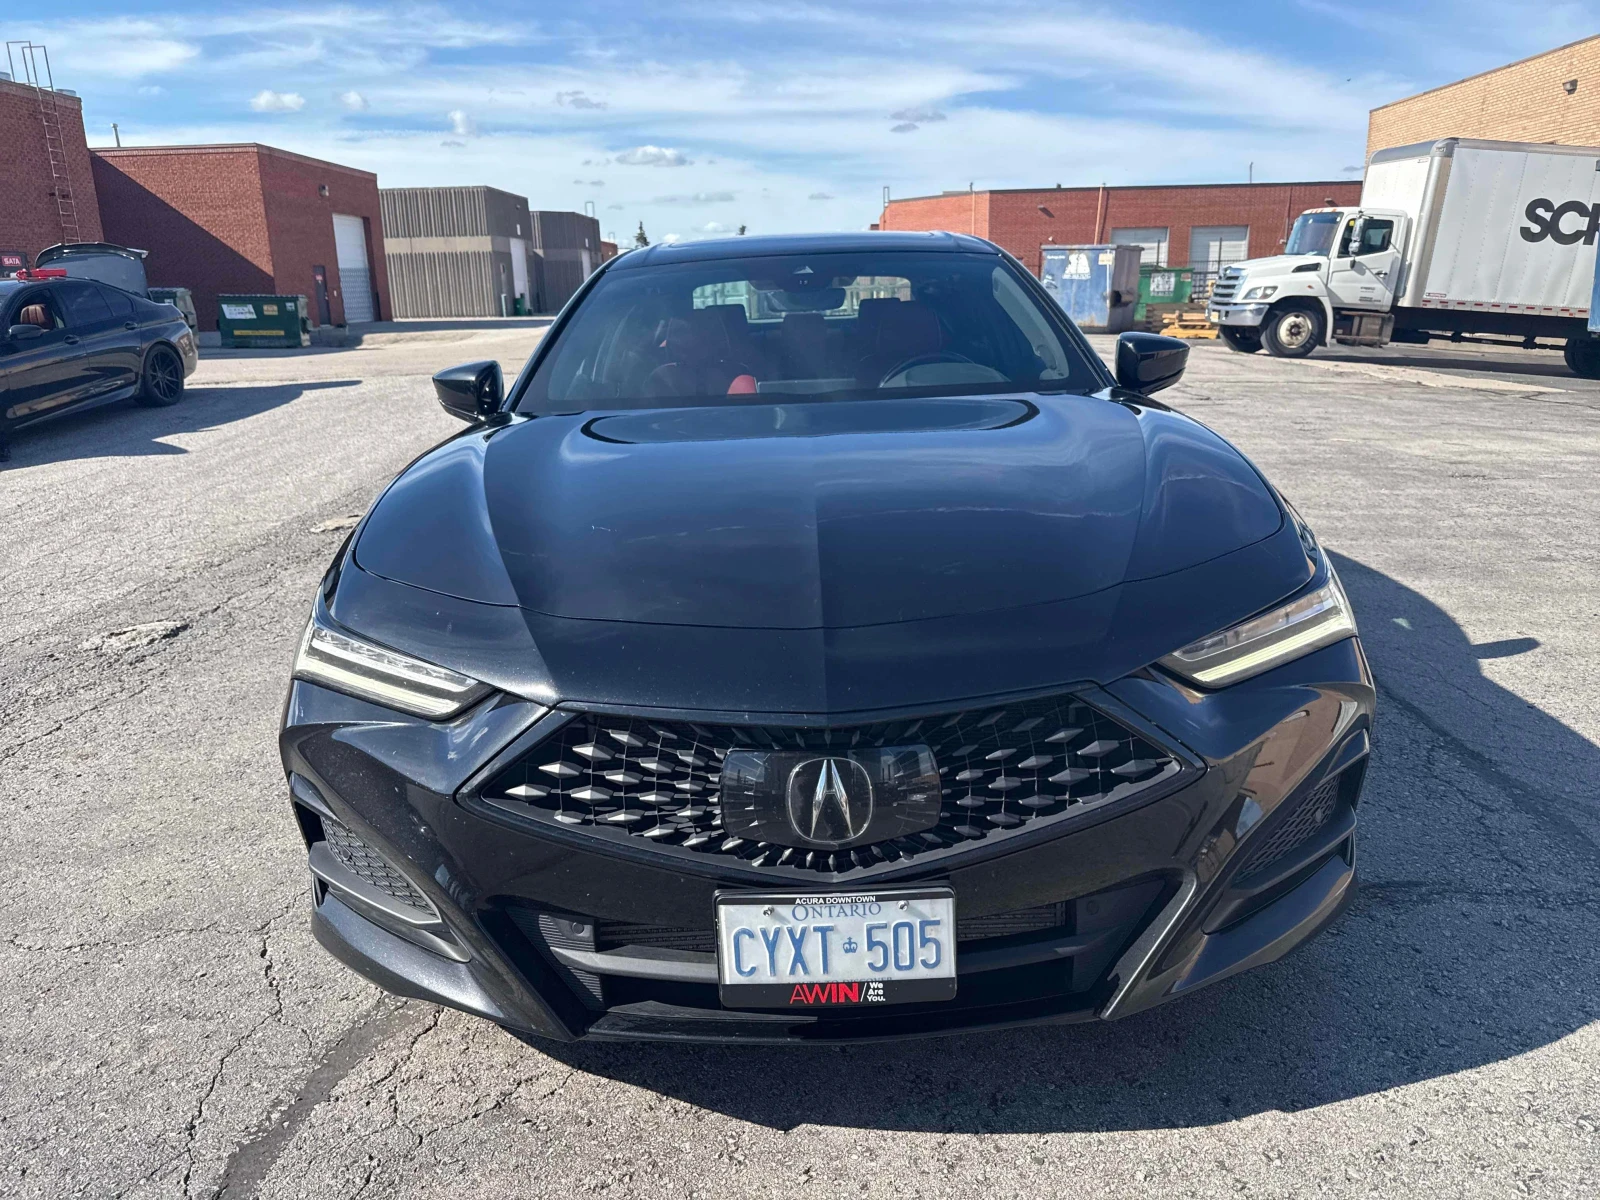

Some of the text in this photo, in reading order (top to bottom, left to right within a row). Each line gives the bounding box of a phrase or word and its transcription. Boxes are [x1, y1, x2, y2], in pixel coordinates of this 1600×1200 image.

[795, 895, 876, 905] ACURA DOWNTOWN
[791, 902, 882, 922] ONTARIO
[732, 919, 942, 978] CYXT 505
[789, 982, 859, 1004] AWIN
[869, 981, 884, 989] We
